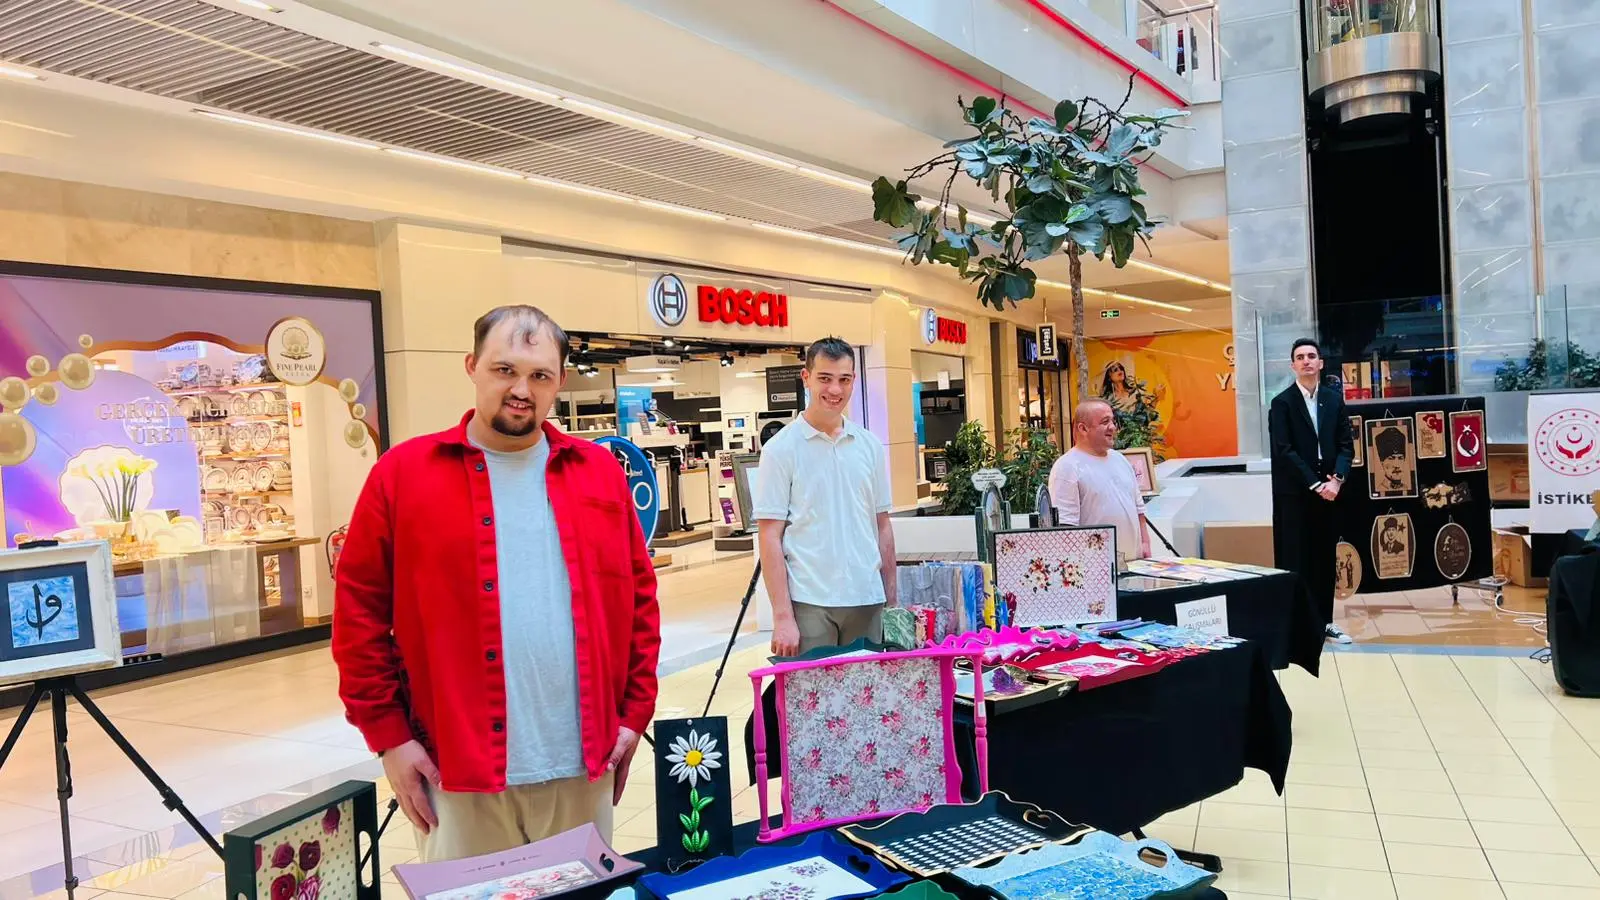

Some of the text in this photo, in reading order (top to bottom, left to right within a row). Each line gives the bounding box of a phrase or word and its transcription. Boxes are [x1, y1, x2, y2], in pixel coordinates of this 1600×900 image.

[697, 285, 788, 327] BOSCH
[937, 316, 966, 344] BOSCH
[277, 363, 317, 371] FINE PEARL
